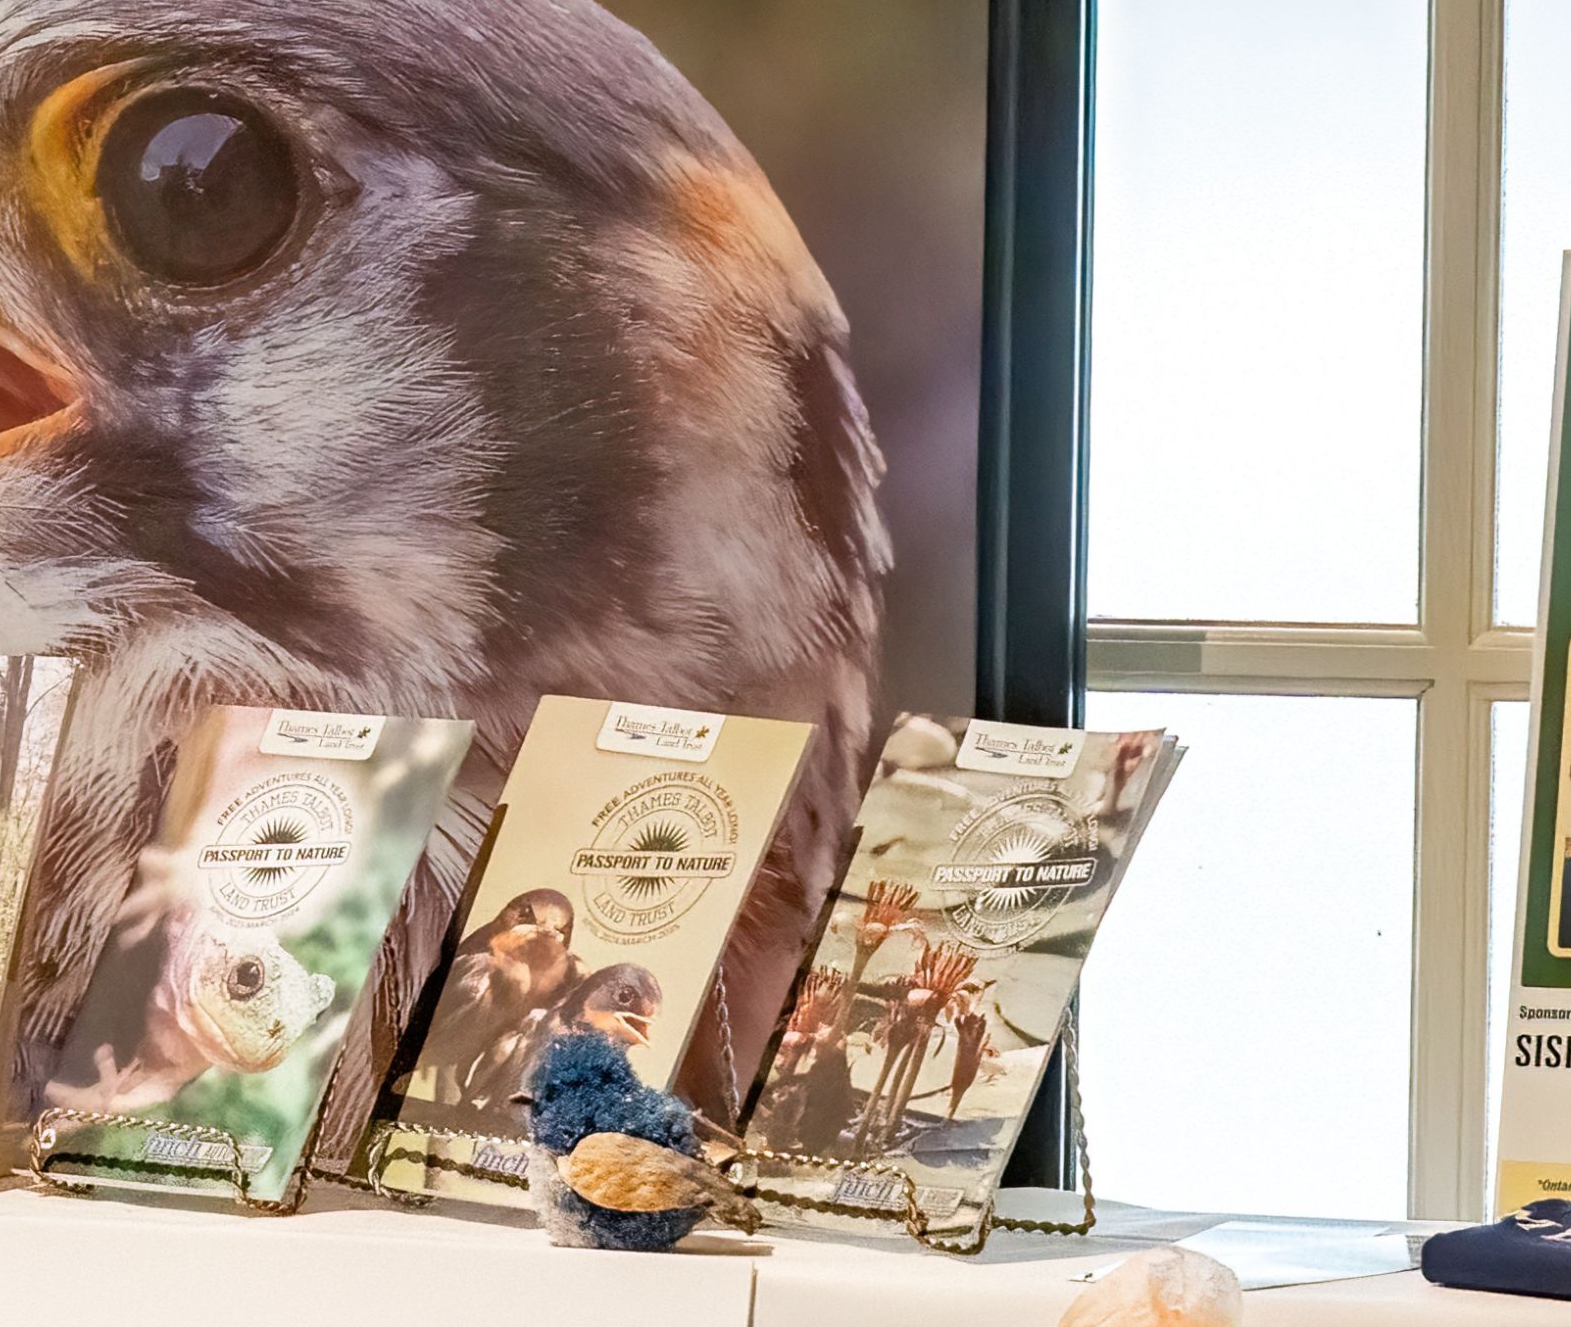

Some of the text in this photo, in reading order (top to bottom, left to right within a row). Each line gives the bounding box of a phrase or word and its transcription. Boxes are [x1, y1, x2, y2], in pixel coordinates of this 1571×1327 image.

[203, 846, 346, 862] PASSPORT TO NATURE
[577, 854, 731, 871] PASSPORT TO NATURE
[934, 863, 1091, 883] PASSPORT TO NATURE
